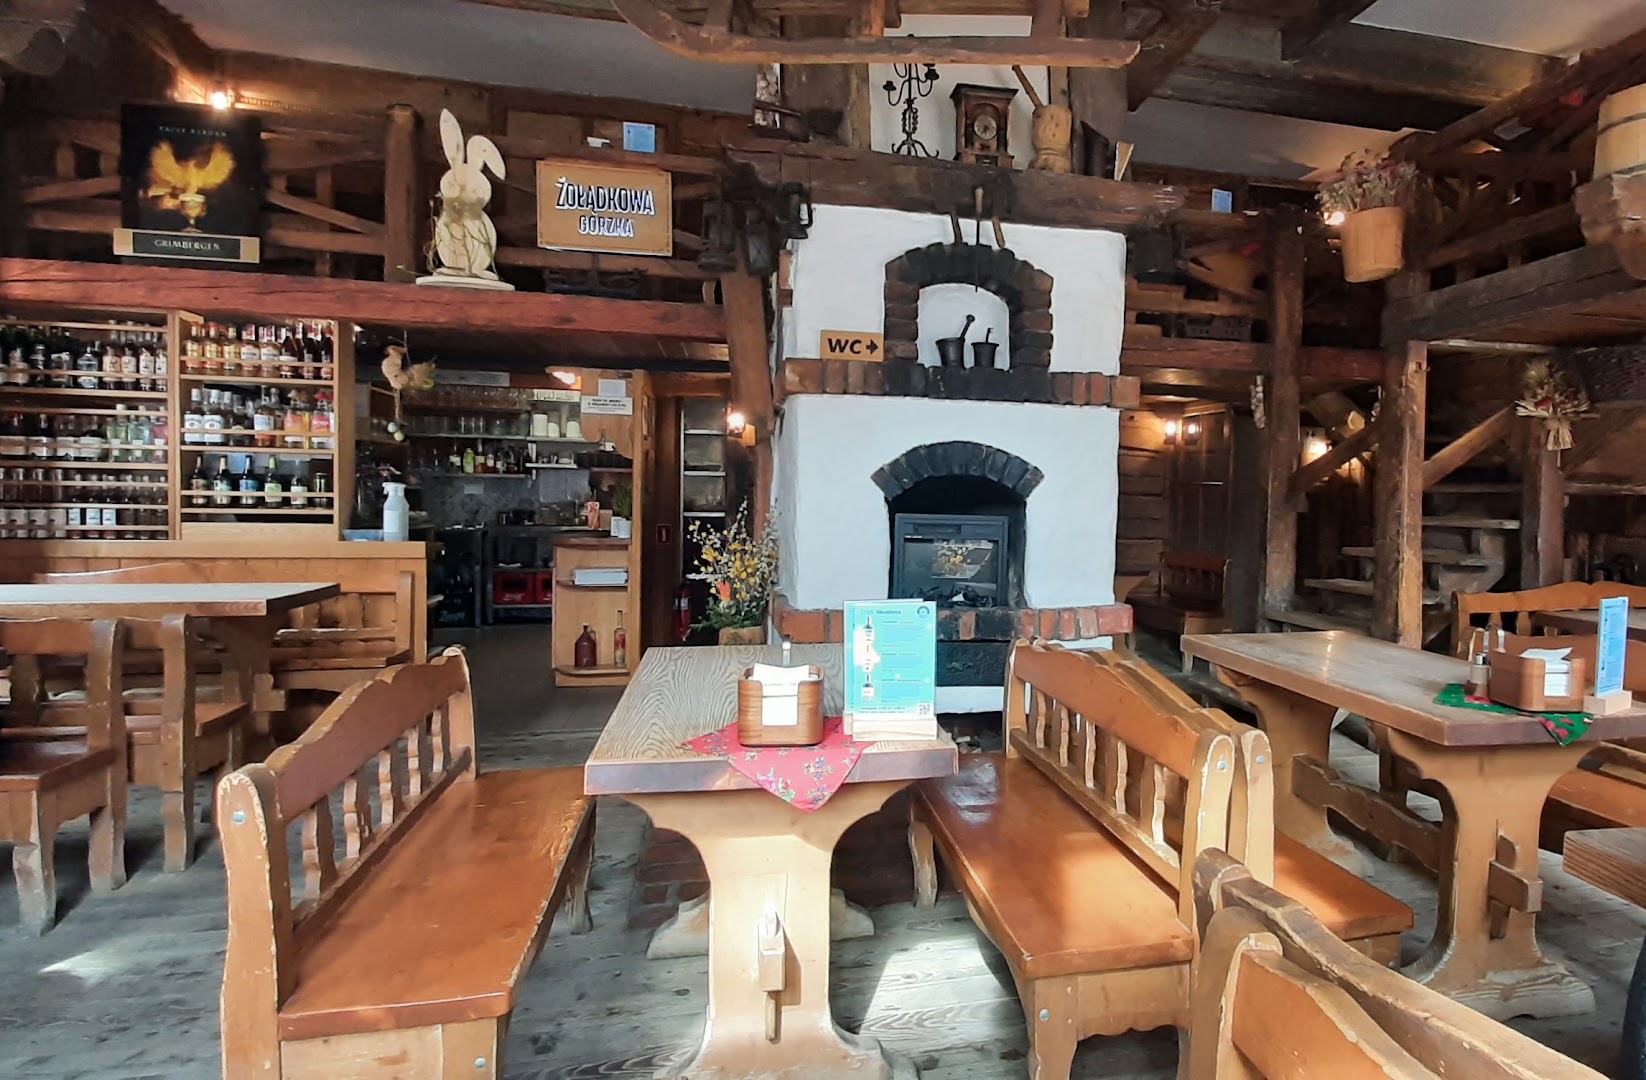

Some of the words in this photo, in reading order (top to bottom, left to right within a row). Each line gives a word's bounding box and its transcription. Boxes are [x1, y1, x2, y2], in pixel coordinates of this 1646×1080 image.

[555, 176, 656, 216] ŻOŁĄDKOWA
[578, 215, 635, 238] GORZKA
[154, 238, 220, 251] GRIMBERGEN
[827, 338, 862, 354] WC
